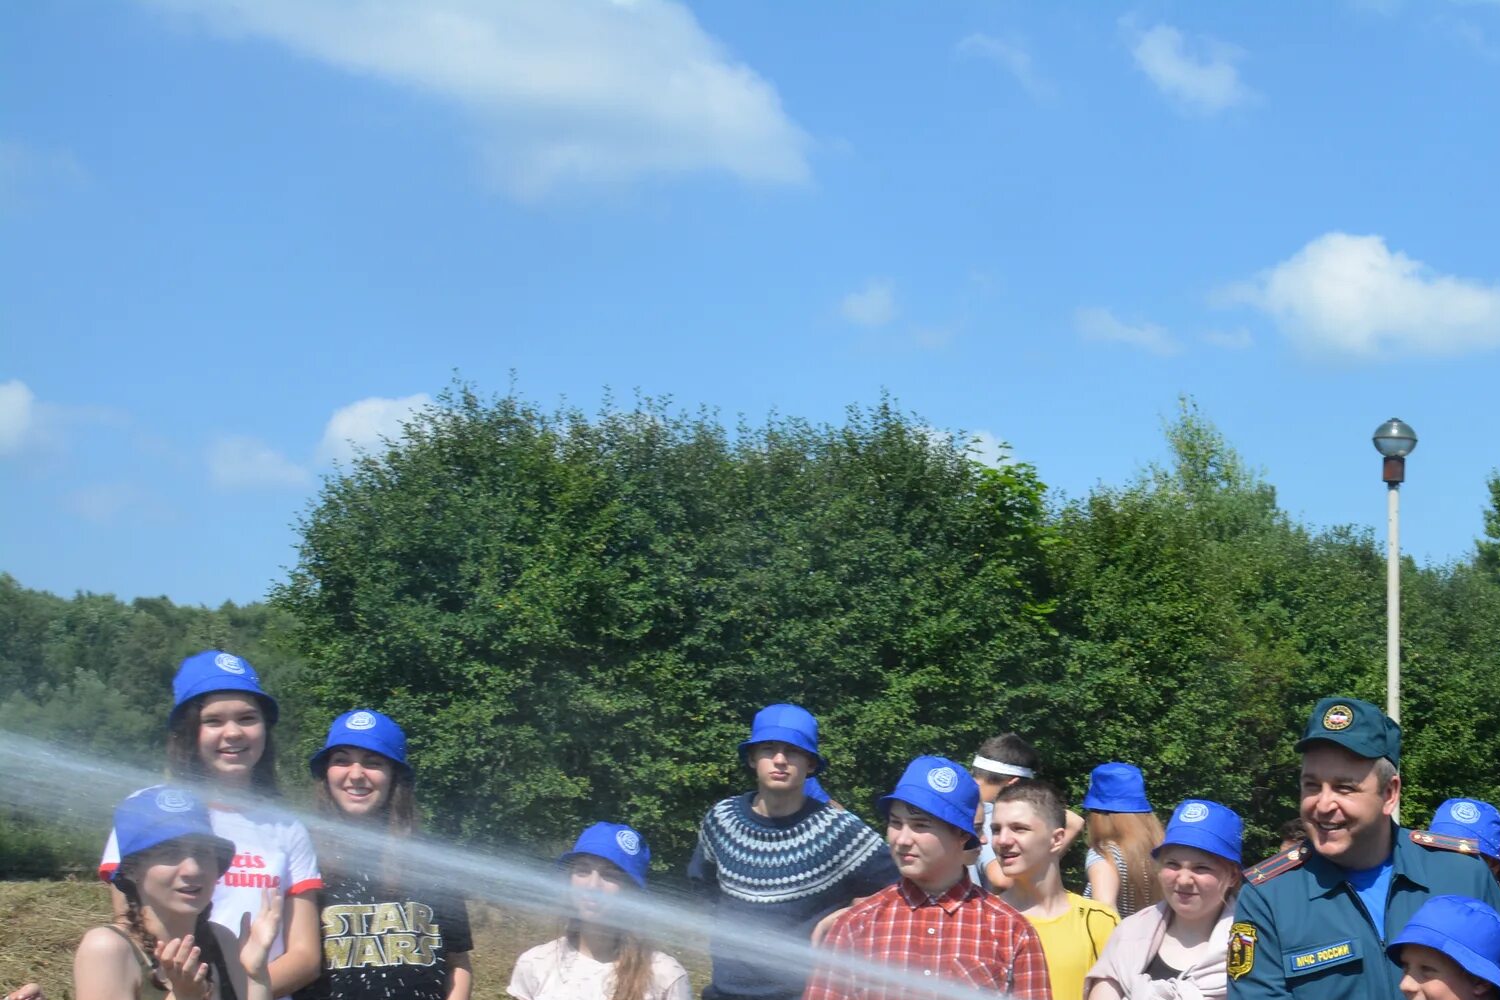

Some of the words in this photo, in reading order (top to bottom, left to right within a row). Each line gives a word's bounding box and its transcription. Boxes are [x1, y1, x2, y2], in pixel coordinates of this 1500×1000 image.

[232, 852, 265, 868] ris
[321, 901, 440, 937] STAR
[1296, 954, 1315, 967] МЧС
[1317, 944, 1350, 962] РОССИИ
